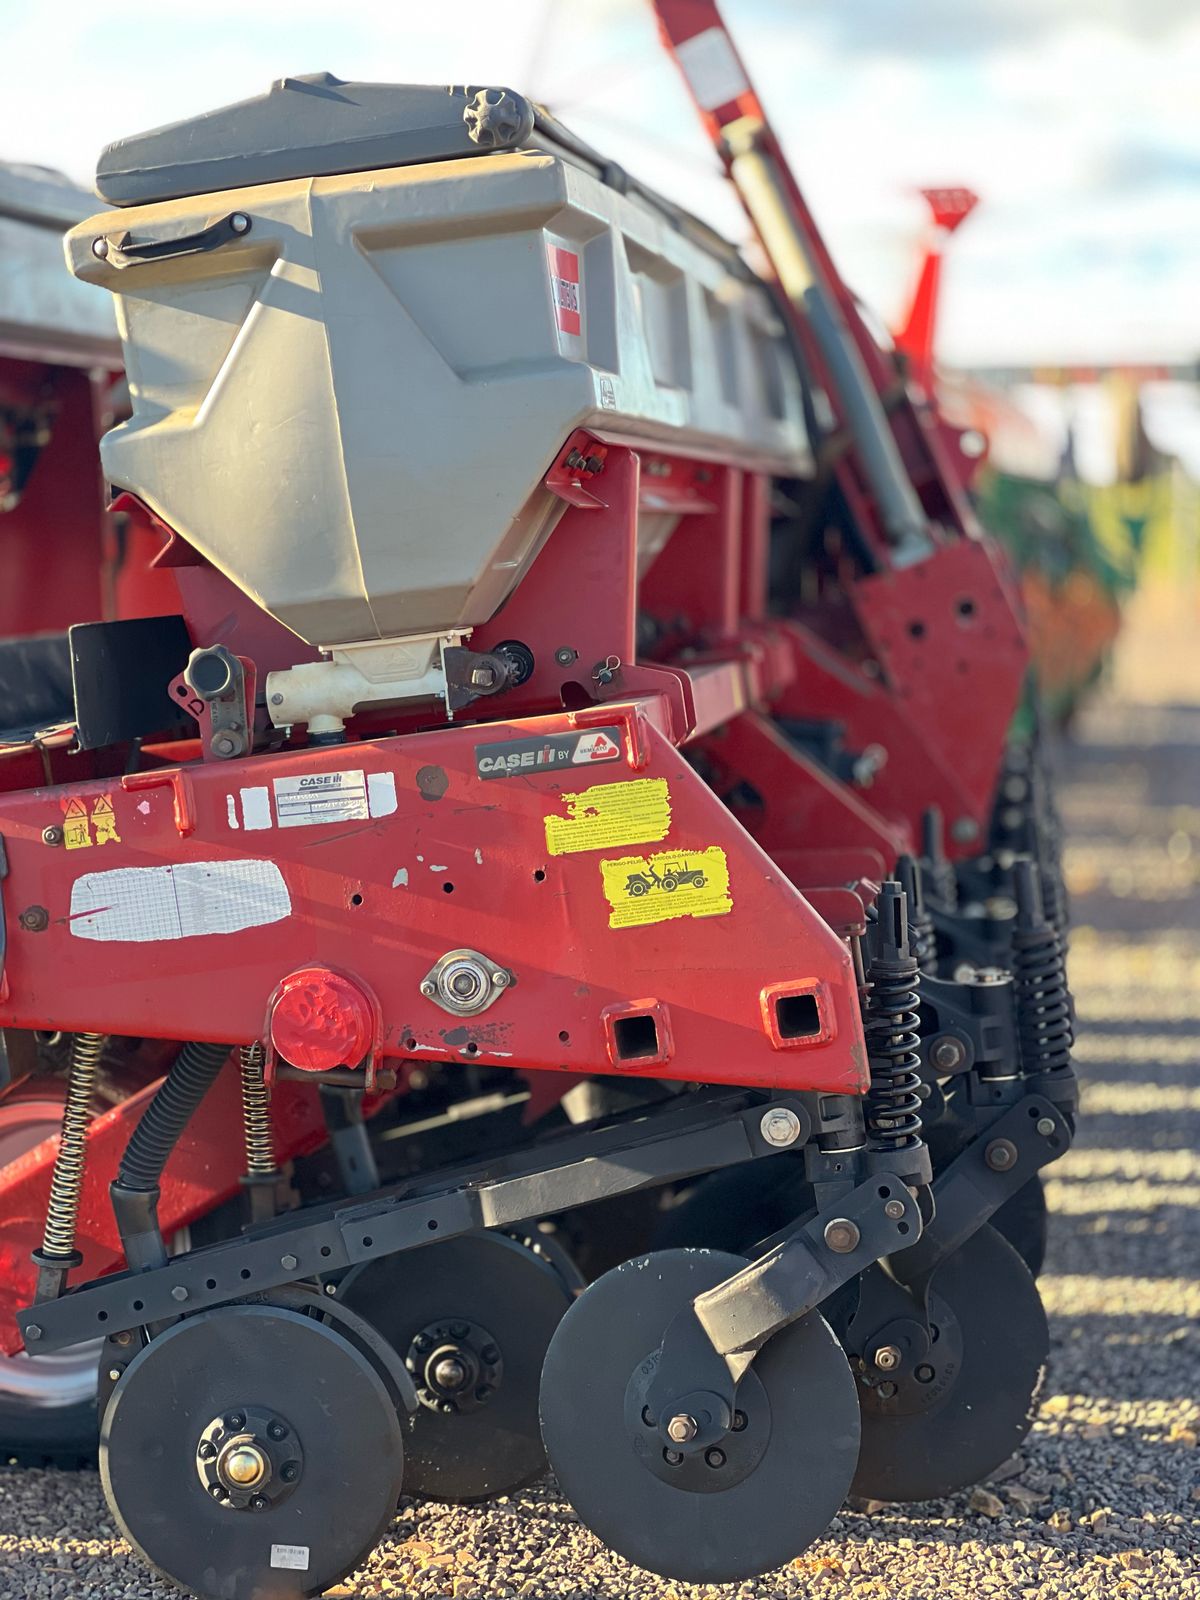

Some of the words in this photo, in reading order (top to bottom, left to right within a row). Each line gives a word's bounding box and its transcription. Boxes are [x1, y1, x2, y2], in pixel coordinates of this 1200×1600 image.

[478, 752, 535, 772] CASE
[558, 750, 570, 760] BY
[300, 776, 331, 786] CASE
